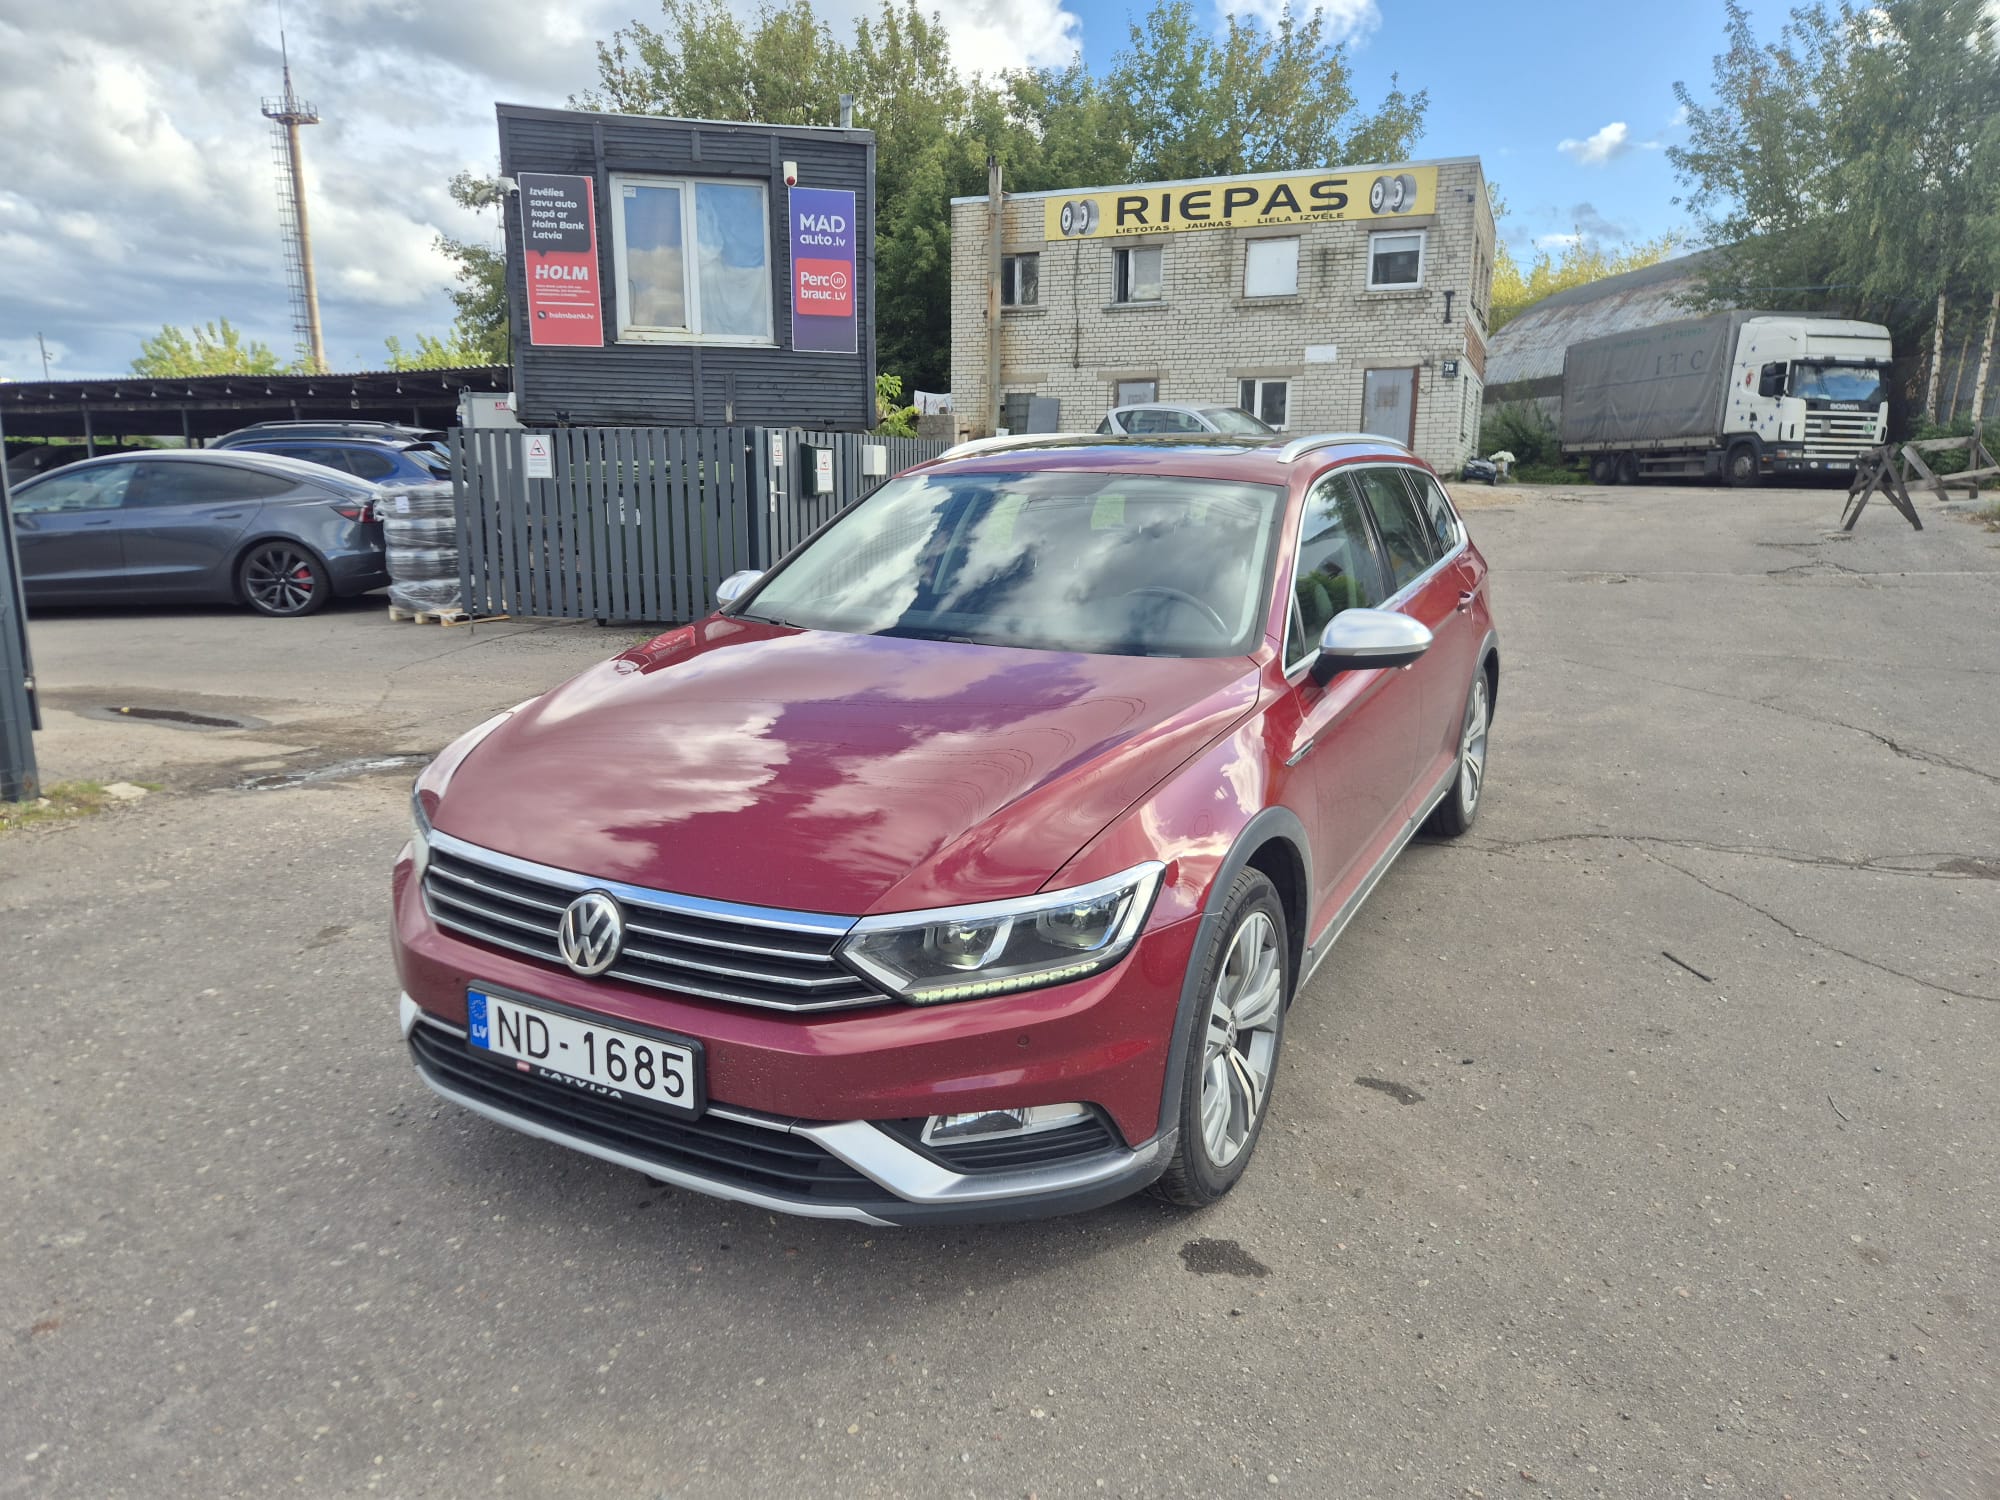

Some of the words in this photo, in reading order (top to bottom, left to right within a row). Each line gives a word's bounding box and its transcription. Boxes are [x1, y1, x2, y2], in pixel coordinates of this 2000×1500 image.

[529, 187, 564, 197] Izvēlies
[530, 199, 553, 207] savu
[555, 200, 577, 208] auto
[1116, 179, 1349, 226] RIEPAS
[531, 208, 555, 219] kopā
[532, 219, 557, 229] Holm
[560, 221, 584, 230] Bank
[800, 213, 846, 233] MAD
[1185, 220, 1232, 229] JAUNAS
[1257, 216, 1292, 224] LIELA
[533, 230, 562, 239] Latvia
[800, 233, 845, 247] auto.lv
[535, 264, 589, 281] HOLM
[801, 271, 830, 286] Perc
[833, 276, 844, 284] un
[801, 286, 846, 301] brauc.LV
[472, 1023, 488, 1038] LV
[539, 1068, 623, 1099] LATVIJA
